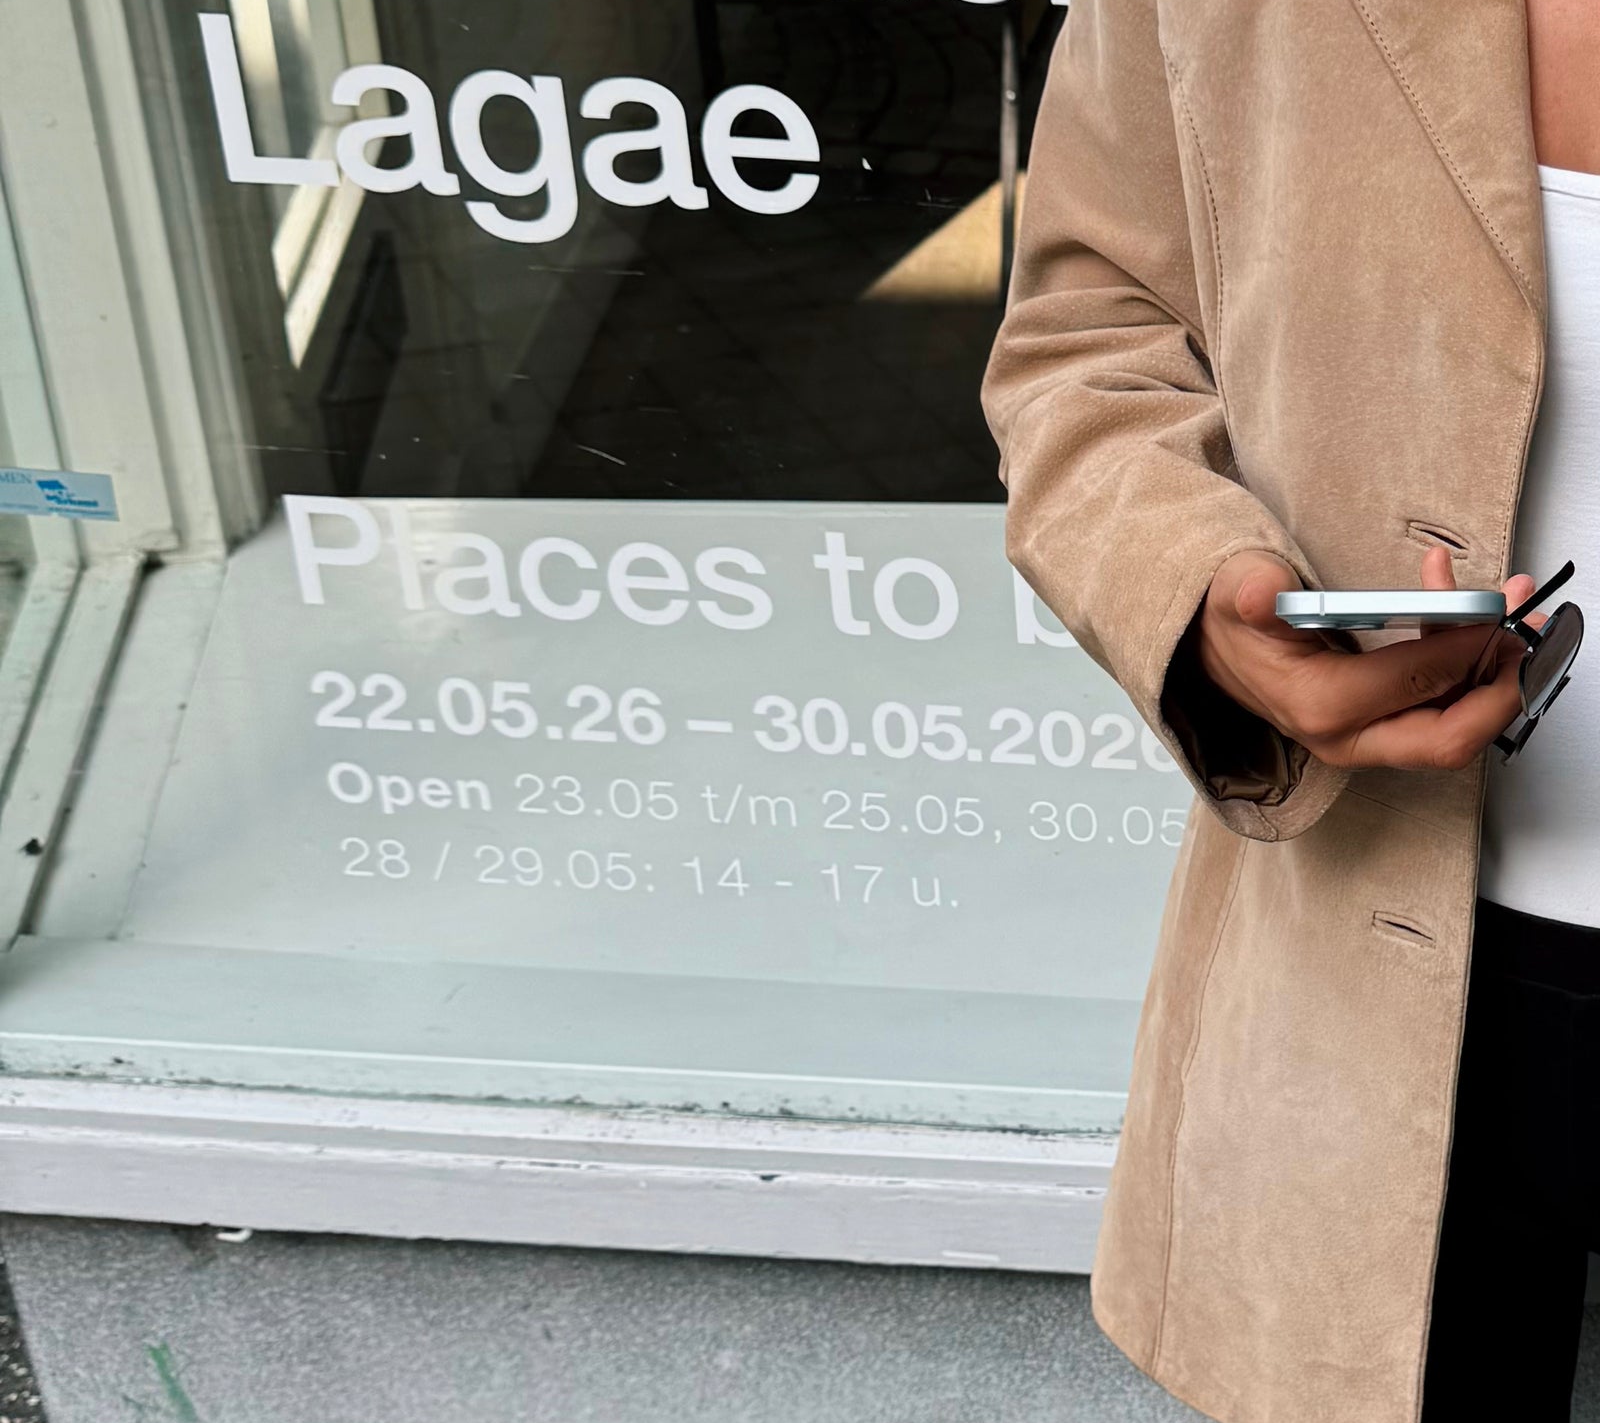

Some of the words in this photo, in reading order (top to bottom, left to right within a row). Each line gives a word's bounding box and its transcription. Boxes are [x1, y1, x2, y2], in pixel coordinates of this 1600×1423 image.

[198, 13, 820, 243] Lagae
[282, 494, 774, 630] Places
[813, 531, 959, 641] to
[310, 670, 667, 745] 22.05.26
[327, 762, 492, 814] Open
[515, 773, 679, 821] 23.05
[701, 784, 797, 828] t/m
[821, 790, 1001, 844] 25.05,
[1029, 801, 1186, 846] 30.05
[340, 837, 410, 878] 28
[475, 845, 655, 892] 29.05:
[682, 858, 749, 897] 14
[821, 865, 883, 903] 17
[912, 876, 959, 908] u.
